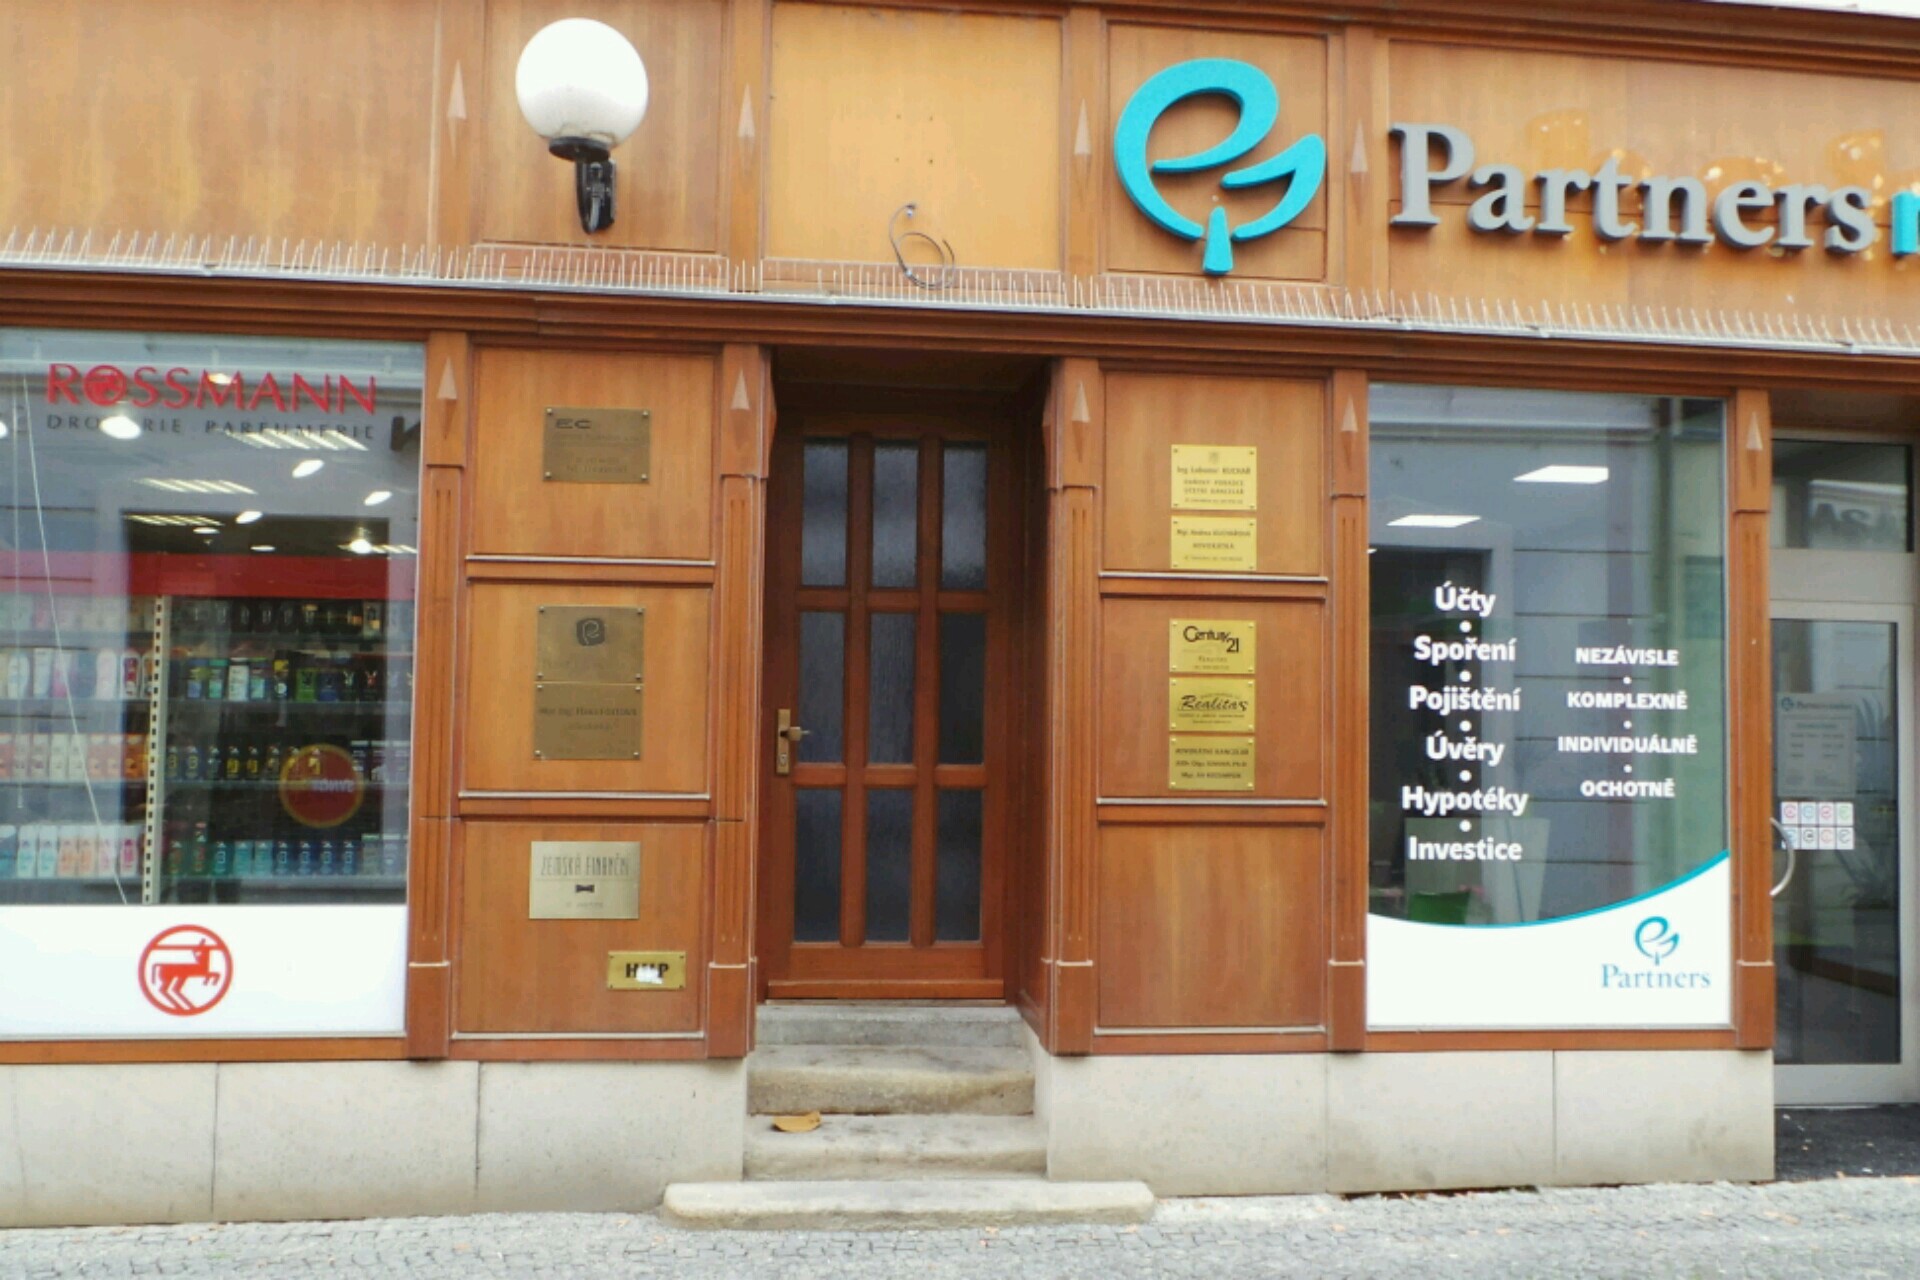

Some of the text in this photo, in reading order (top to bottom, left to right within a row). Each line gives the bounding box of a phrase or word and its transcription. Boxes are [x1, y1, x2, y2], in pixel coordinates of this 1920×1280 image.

[1388, 122, 1876, 255] Partners
[47, 363, 377, 415] ROSSMANN
[1434, 580, 1496, 617] Účty
[1183, 625, 1240, 654] Century 21
[1413, 635, 1517, 666] Spoření
[1575, 645, 1680, 667] NEZÁVISLE
[1409, 685, 1522, 716] Pojištění
[1567, 690, 1689, 710] KOMPLEXNĚ
[1425, 730, 1505, 767] Úvěry
[1557, 734, 1698, 754] INDIVIDUÁLNĚ
[1401, 785, 1529, 817] Hypotéky
[1580, 778, 1676, 798] OCHOTNĚ
[1407, 836, 1524, 861] Investice
[1602, 963, 1711, 989] Partners
